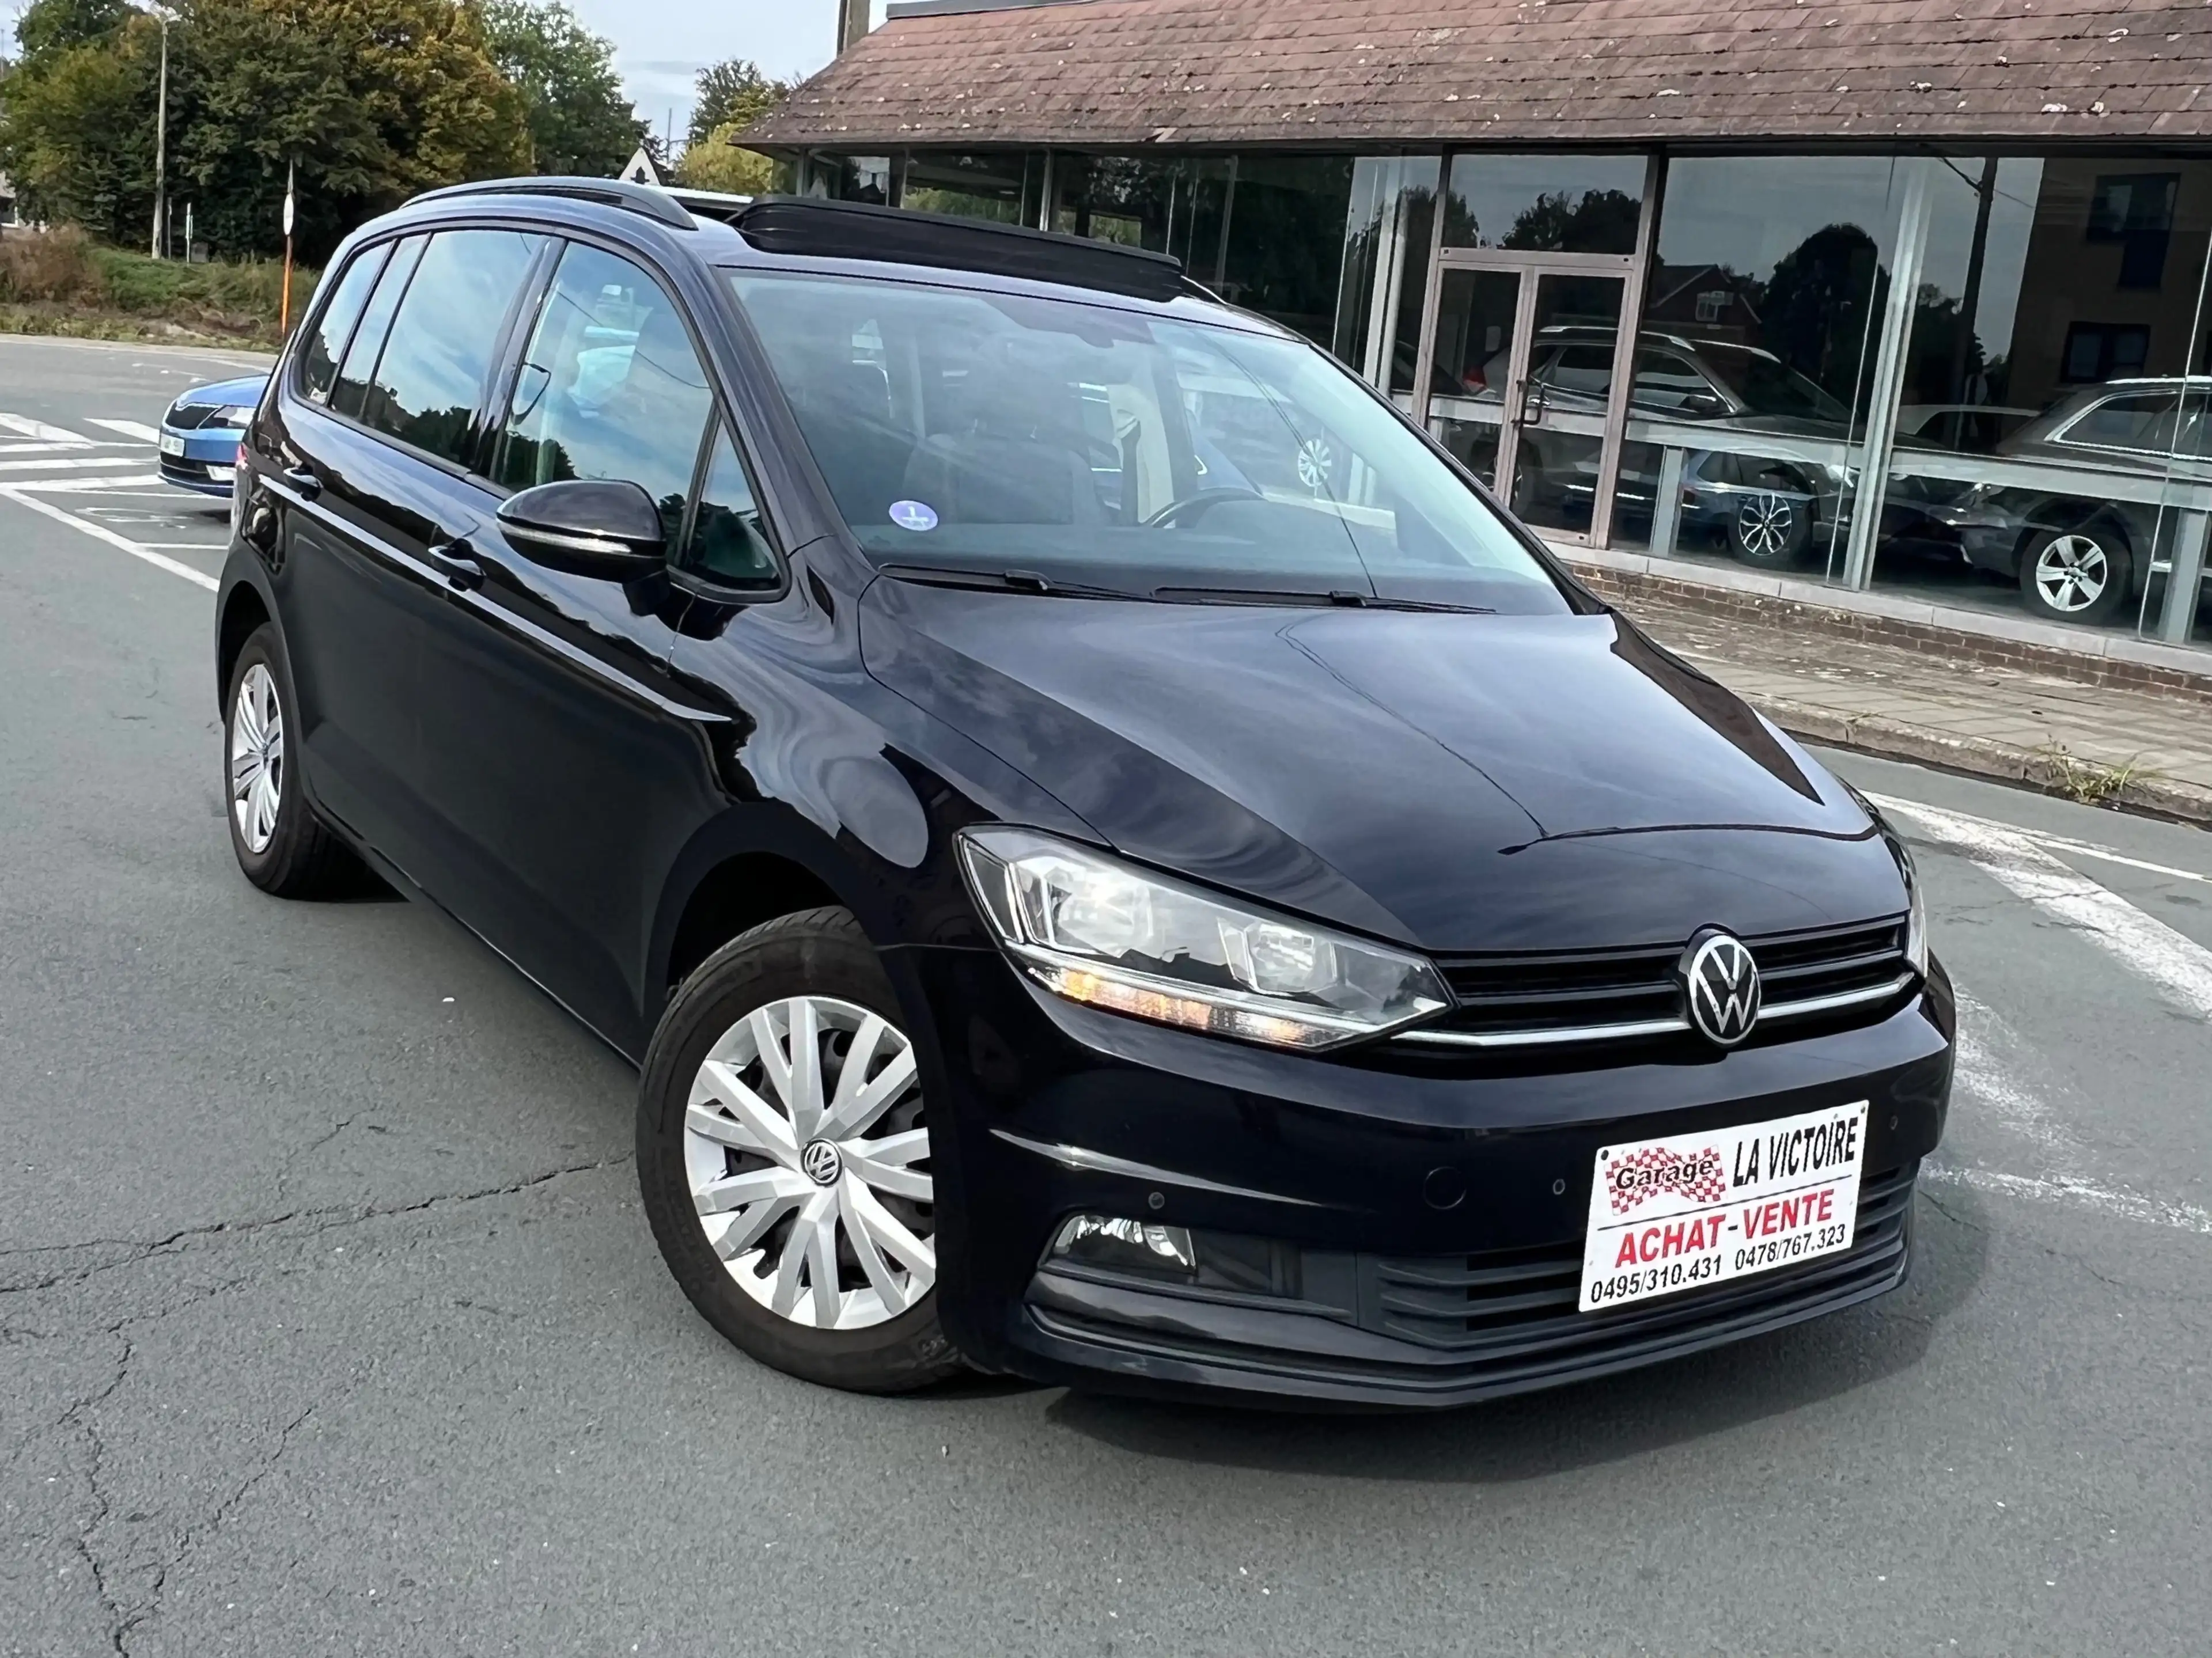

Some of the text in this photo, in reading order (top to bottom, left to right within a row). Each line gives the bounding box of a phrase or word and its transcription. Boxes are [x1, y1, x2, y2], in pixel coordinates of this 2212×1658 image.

[1615, 1116, 1859, 1190] Garage LA VICTOIRE
[1590, 1224, 1846, 1303] 0495/310.431 0478/767.323
